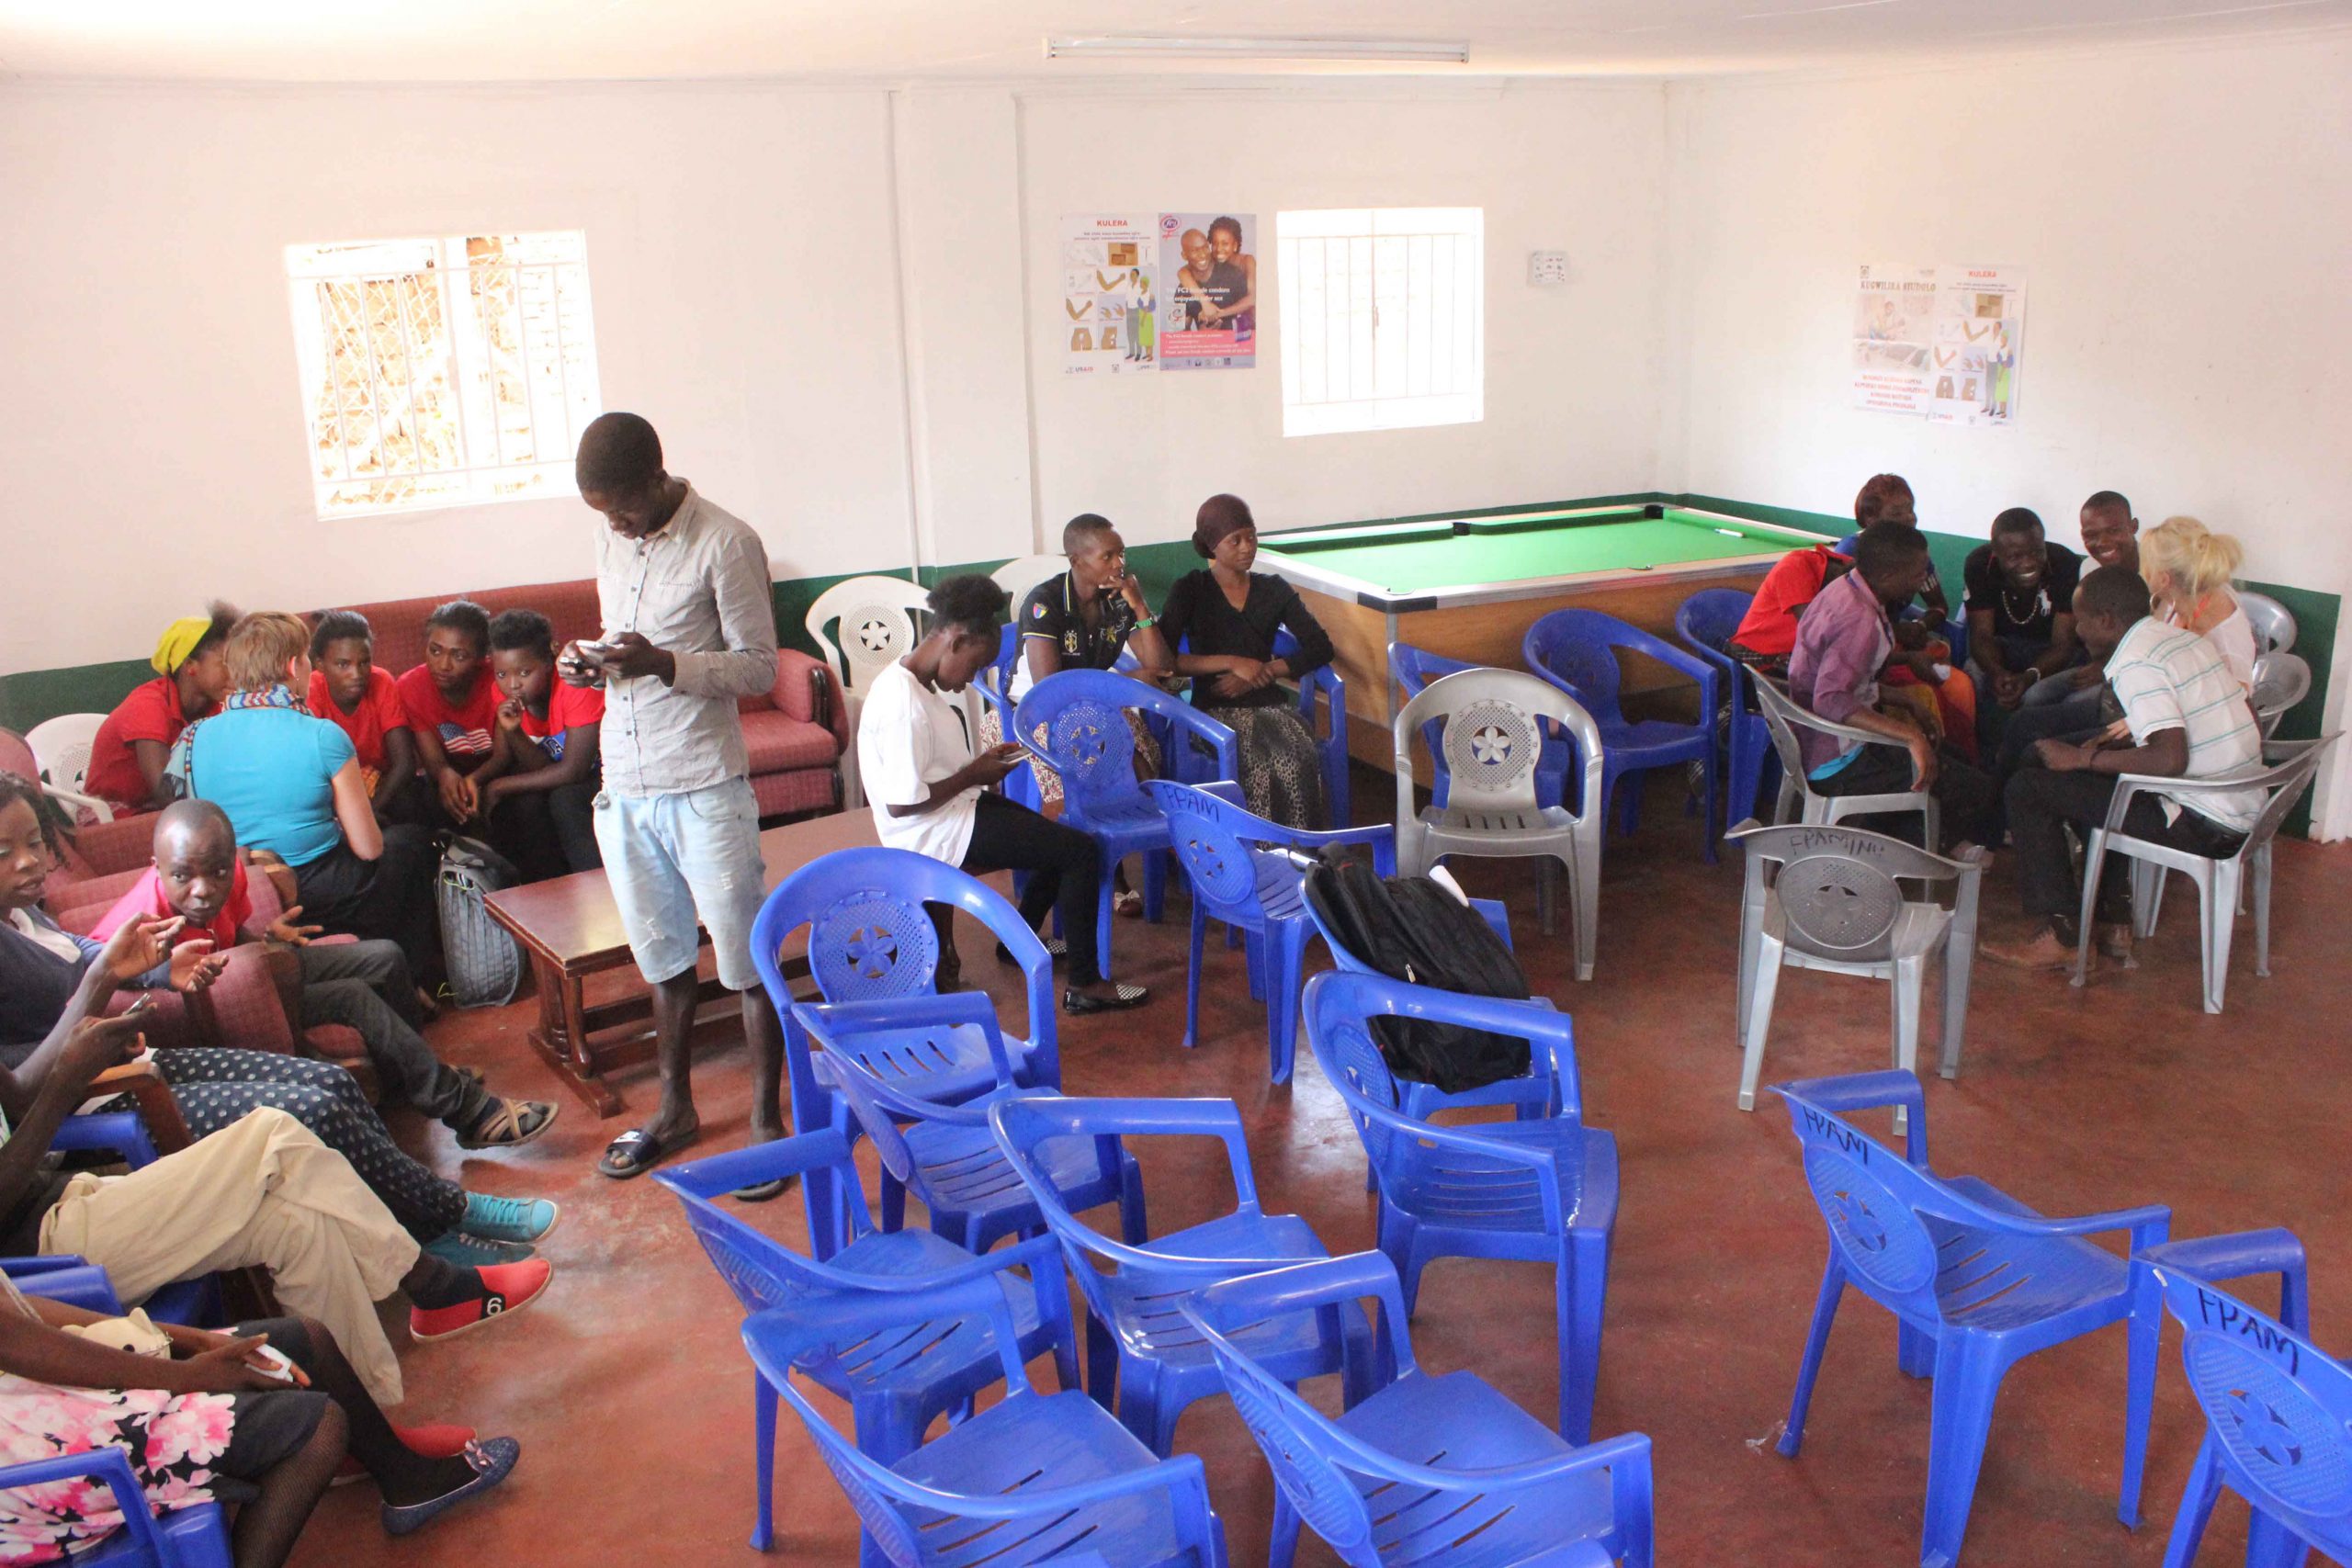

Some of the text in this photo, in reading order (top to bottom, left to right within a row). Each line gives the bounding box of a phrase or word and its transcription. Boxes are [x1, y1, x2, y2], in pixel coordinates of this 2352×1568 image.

[1163, 784, 1219, 823] FPAM
[1803, 1105, 1868, 1166] FPAM
[2198, 1287, 2299, 1377] FPAM
